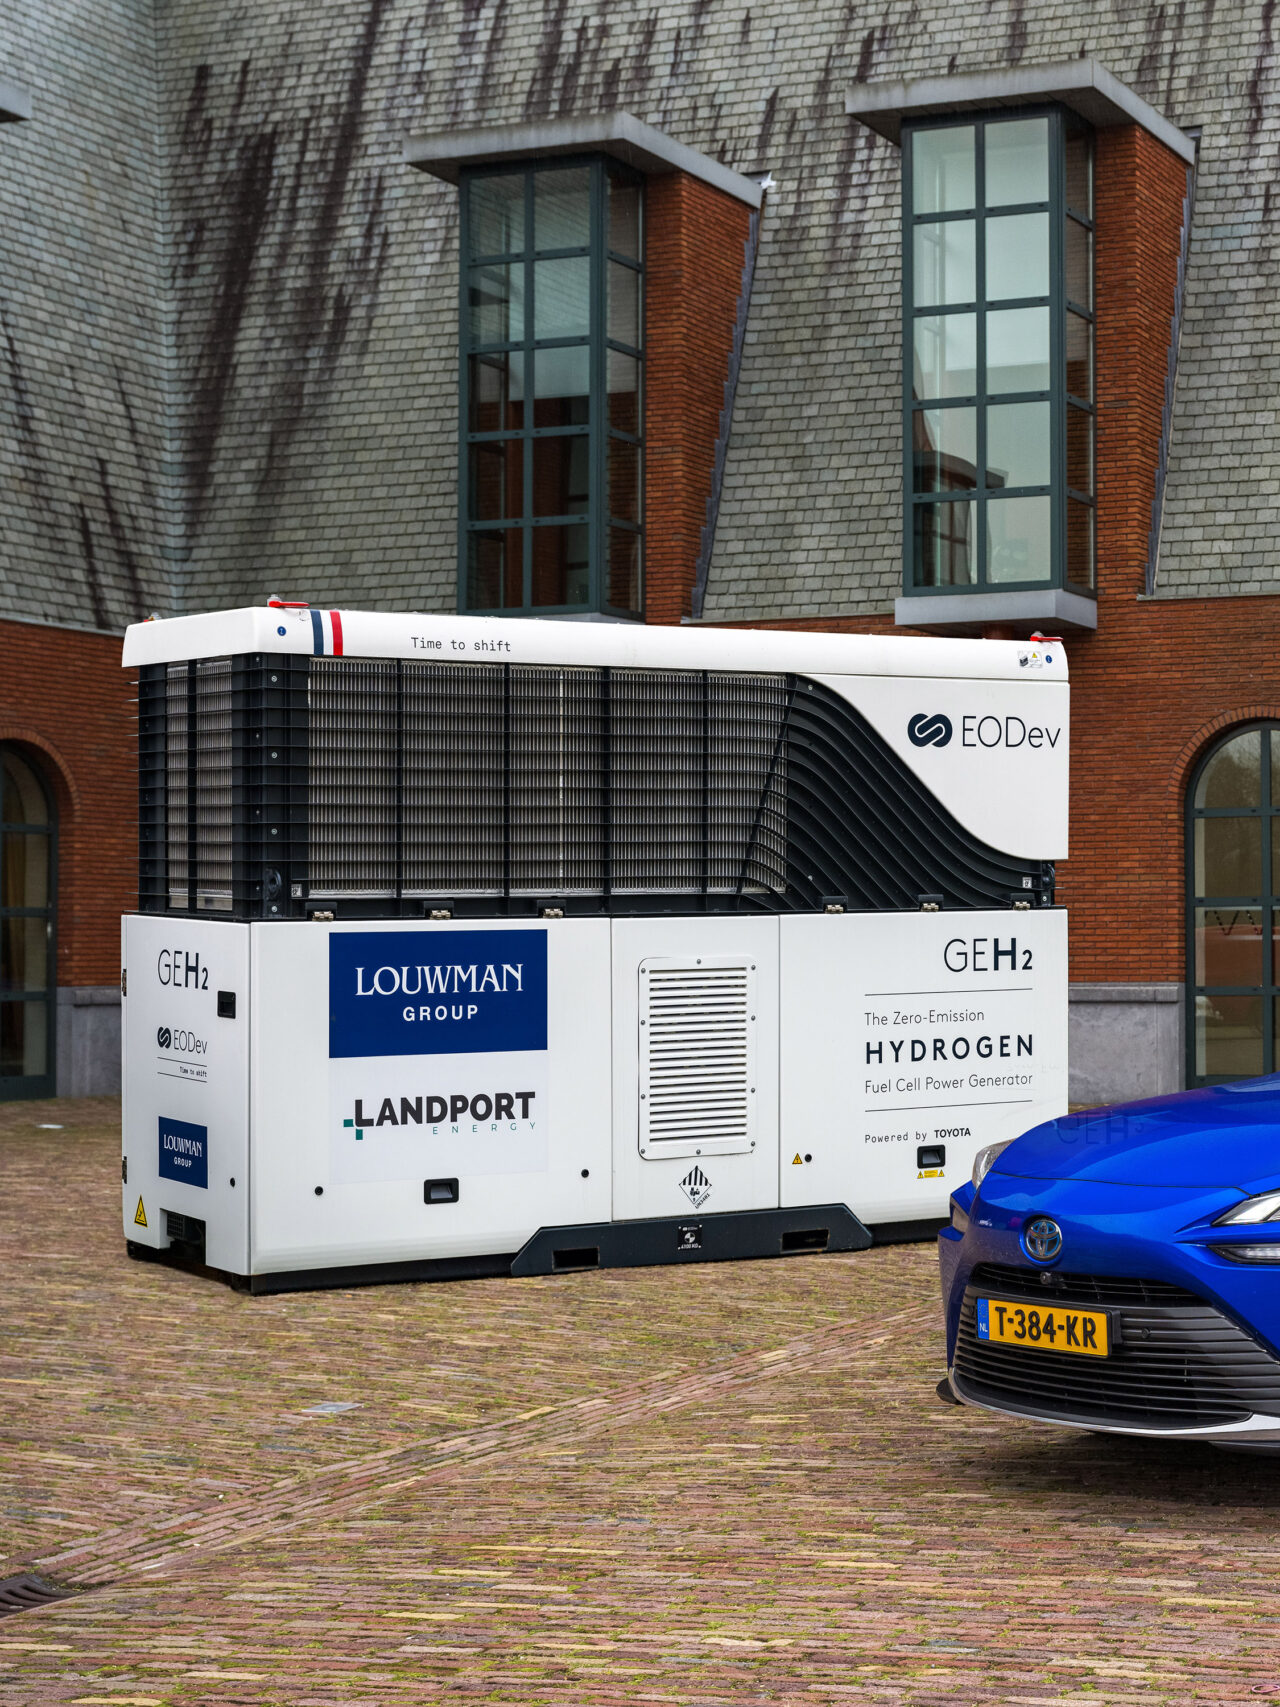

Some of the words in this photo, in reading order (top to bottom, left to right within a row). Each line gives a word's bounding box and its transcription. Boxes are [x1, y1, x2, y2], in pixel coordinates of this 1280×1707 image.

[411, 636, 442, 650] Time
[450, 639, 466, 650] to
[474, 639, 511, 652] shift
[962, 715, 1061, 748] EODev
[943, 937, 1033, 973] GEH2
[157, 948, 208, 990] GEH2
[355, 963, 524, 996] LOUWMAN
[402, 1005, 479, 1022] GROUP
[864, 1012, 888, 1026] The
[893, 1009, 985, 1025] Zero-Emission
[173, 1029, 208, 1054] EODev
[866, 1034, 1033, 1064] HYDROGEN
[865, 1079, 891, 1094] Fuel
[896, 1077, 921, 1092] Cell
[925, 1076, 965, 1091] Power
[968, 1073, 1033, 1088] Generator
[354, 1091, 536, 1128] LANDPORT
[432, 1122, 536, 1135] ENERGY
[864, 1131, 909, 1144] Powered
[915, 1131, 928, 1142] by
[933, 1128, 971, 1139] TOYOTA
[163, 1134, 203, 1158] LOUWMAN
[173, 1156, 192, 1168] GROUP
[979, 1322, 988, 1333] NL
[994, 1306, 1098, 1349] T-384-KR
